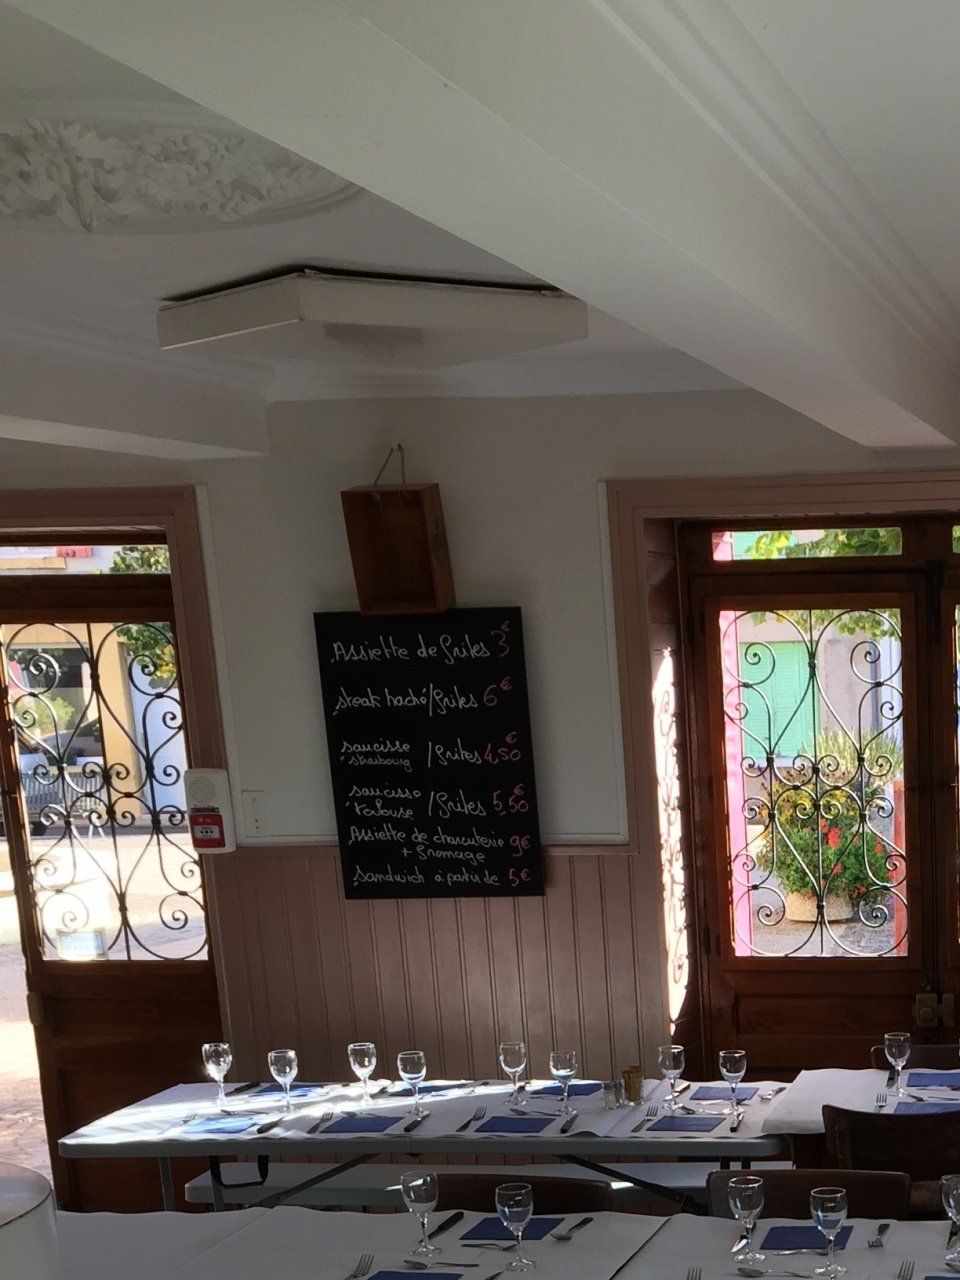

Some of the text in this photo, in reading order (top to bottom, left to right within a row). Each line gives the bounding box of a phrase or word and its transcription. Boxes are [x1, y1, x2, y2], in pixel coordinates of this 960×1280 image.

[332, 634, 410, 661] Assiette
[416, 632, 438, 659] de
[439, 634, 491, 664] frites
[340, 737, 412, 753] saucisse
[350, 823, 407, 843] Assiette
[411, 827, 430, 844] de
[432, 826, 505, 848] charcuterie
[416, 844, 486, 866] fromage
[483, 870, 500, 886] de
